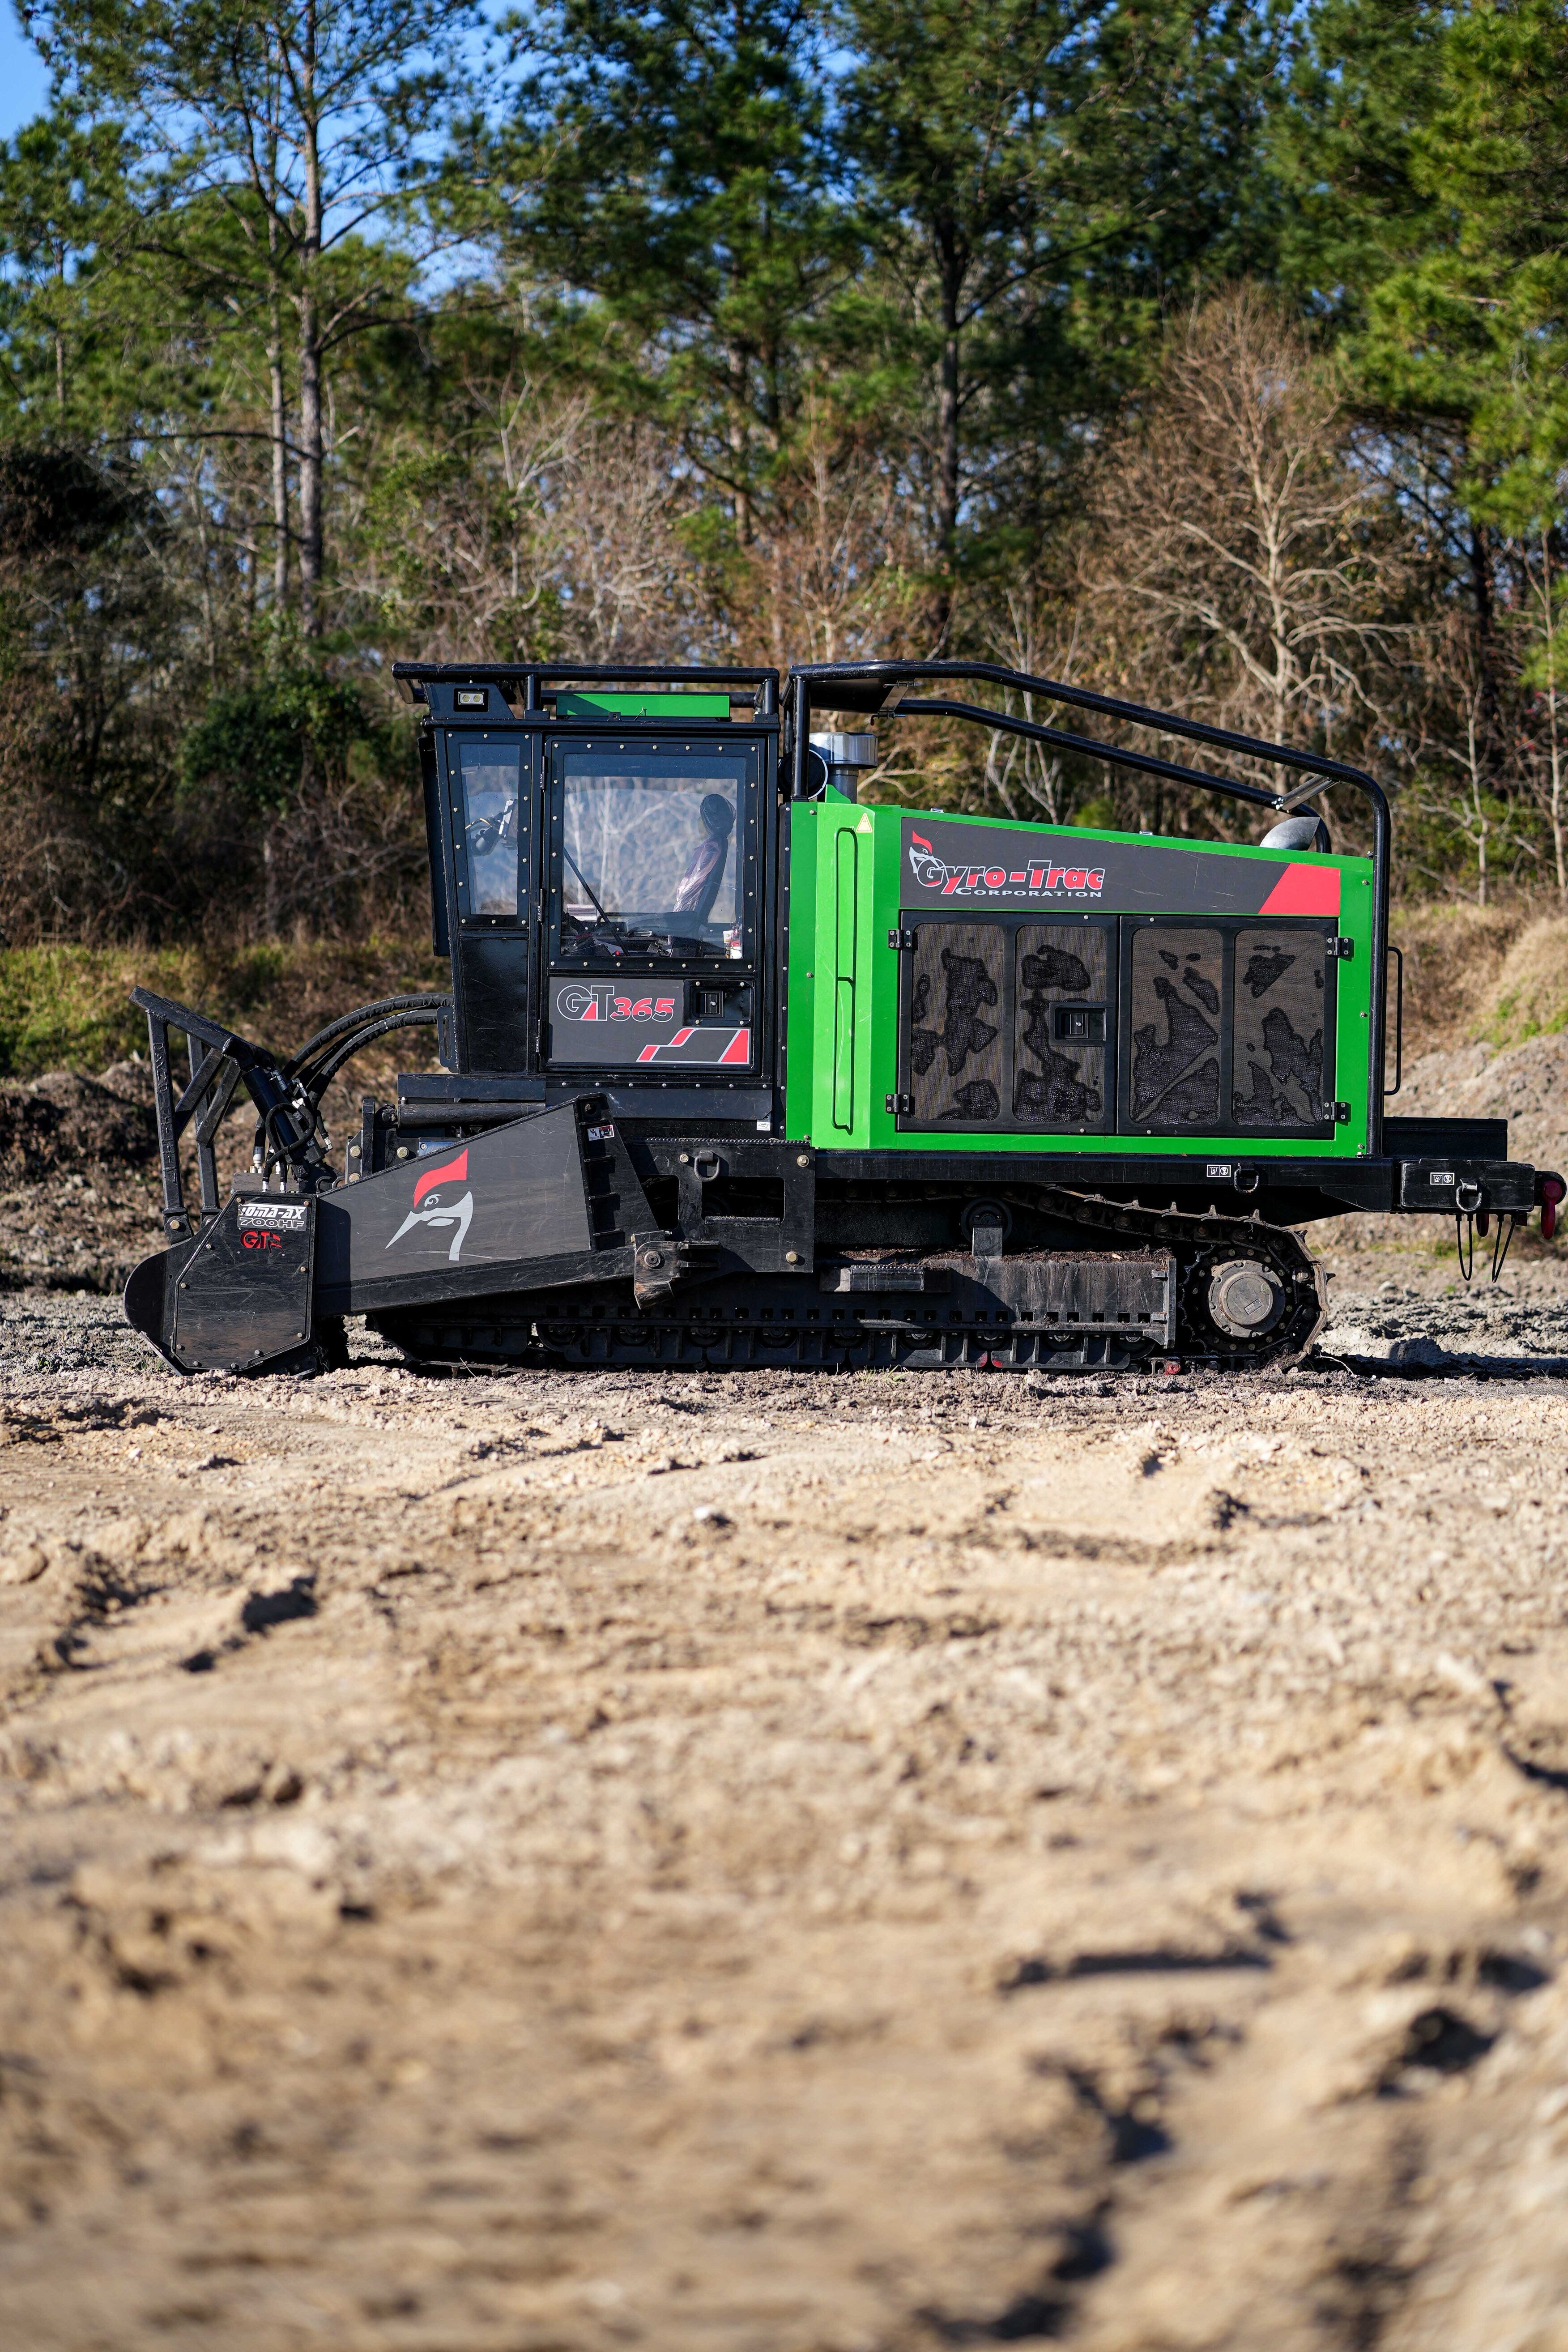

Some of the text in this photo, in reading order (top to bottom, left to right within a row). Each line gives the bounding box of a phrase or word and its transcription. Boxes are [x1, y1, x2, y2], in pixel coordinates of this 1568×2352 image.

[916, 857, 1106, 895] Gyro-Trac
[954, 887, 1102, 898] CORPORATION
[239, 1217, 304, 1229] 700HF
